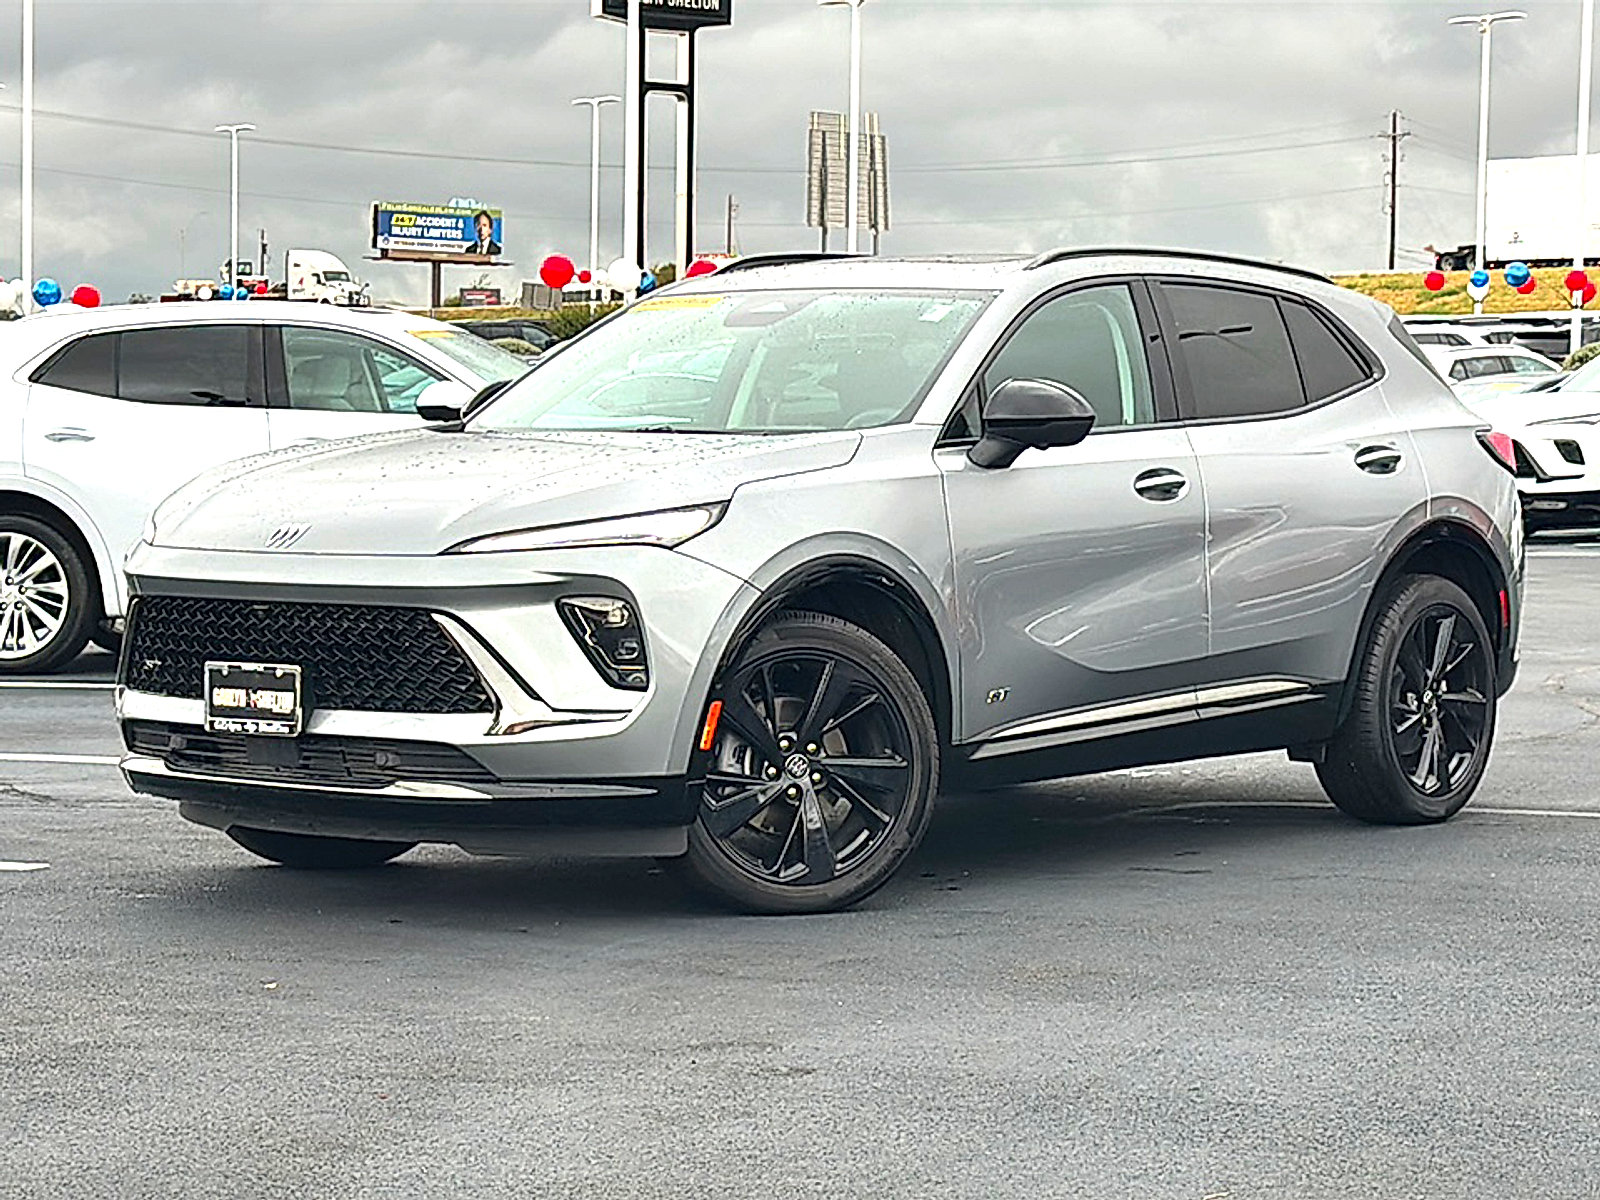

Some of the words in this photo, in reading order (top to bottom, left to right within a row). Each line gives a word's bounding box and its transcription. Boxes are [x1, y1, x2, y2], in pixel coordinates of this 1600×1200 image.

[394, 215, 414, 224] 24/7
[416, 216, 457, 228] ACCIDENT
[457, 219, 464, 229] &
[391, 226, 423, 237] INJURY
[423, 227, 463, 239] LAWYERS
